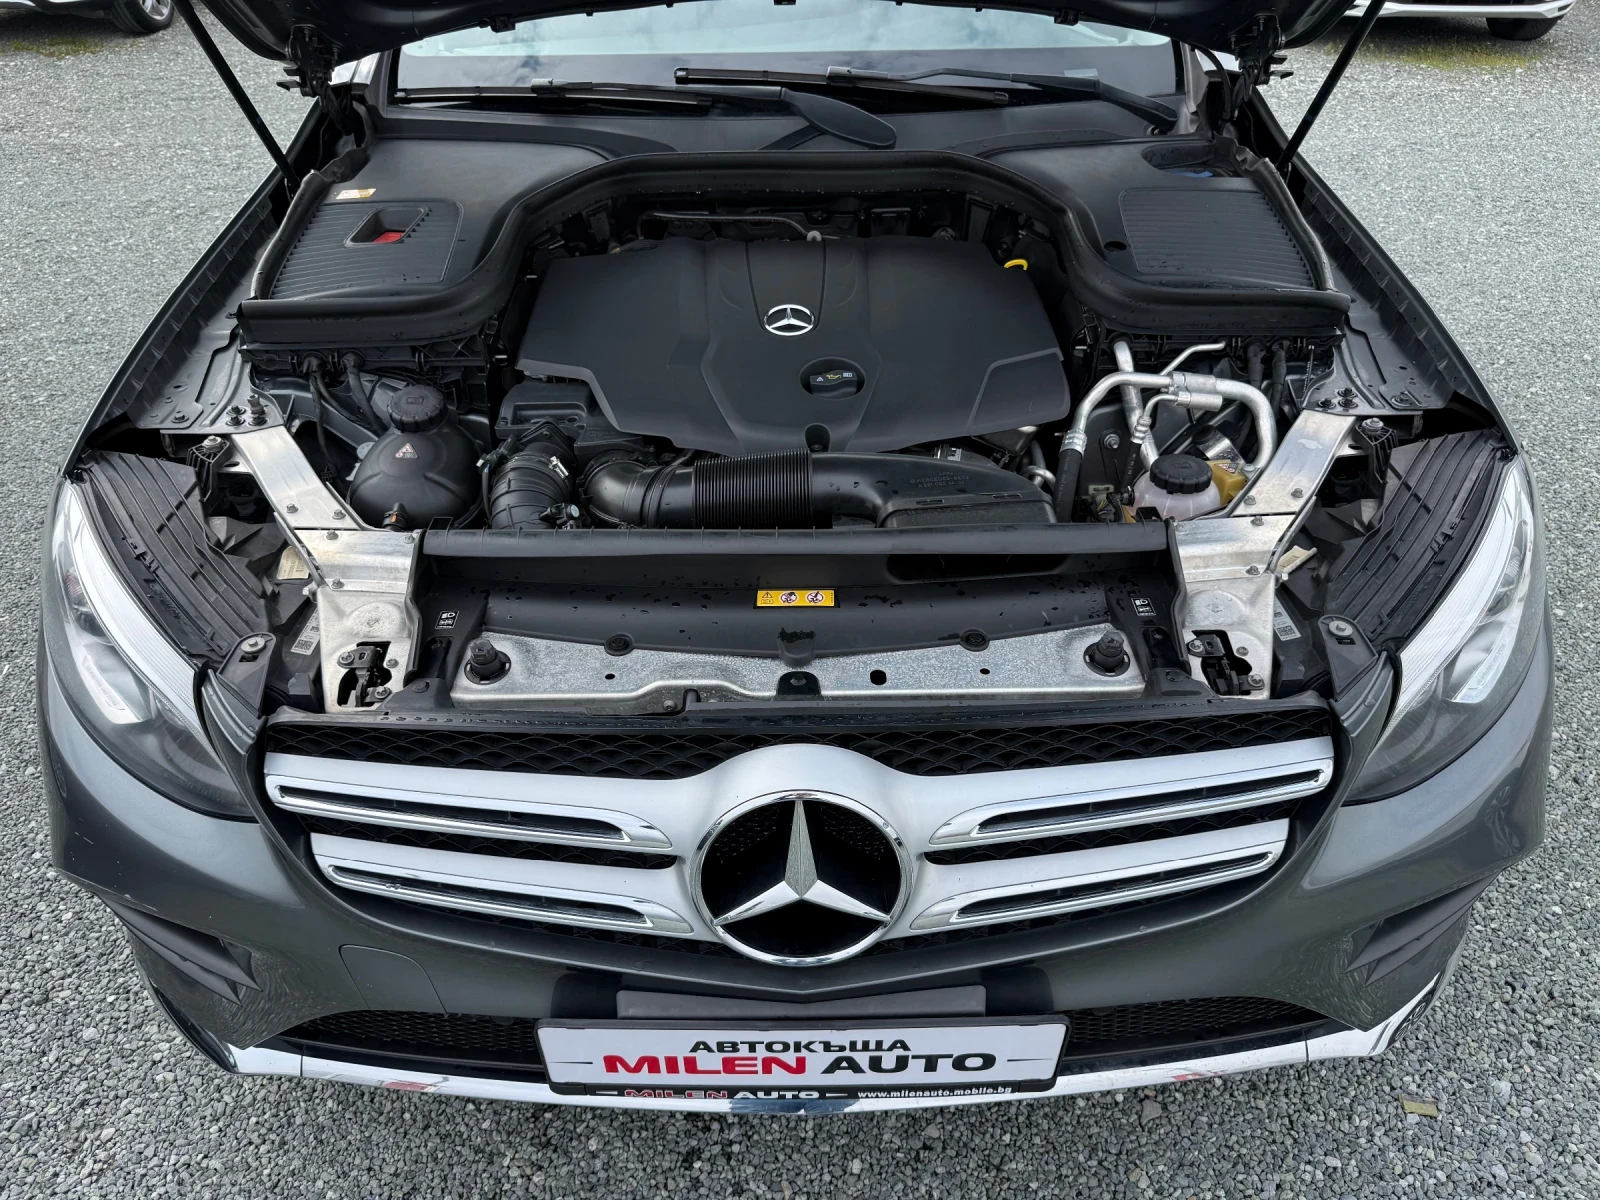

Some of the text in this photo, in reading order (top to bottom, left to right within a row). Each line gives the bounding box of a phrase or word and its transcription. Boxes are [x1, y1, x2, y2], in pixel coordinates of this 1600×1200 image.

[603, 1053, 996, 1075] MILEN AUTO
[624, 1089, 820, 1099] MILEN AUTO
[858, 1086, 1012, 1099] www.milenauto.mobile.bg
